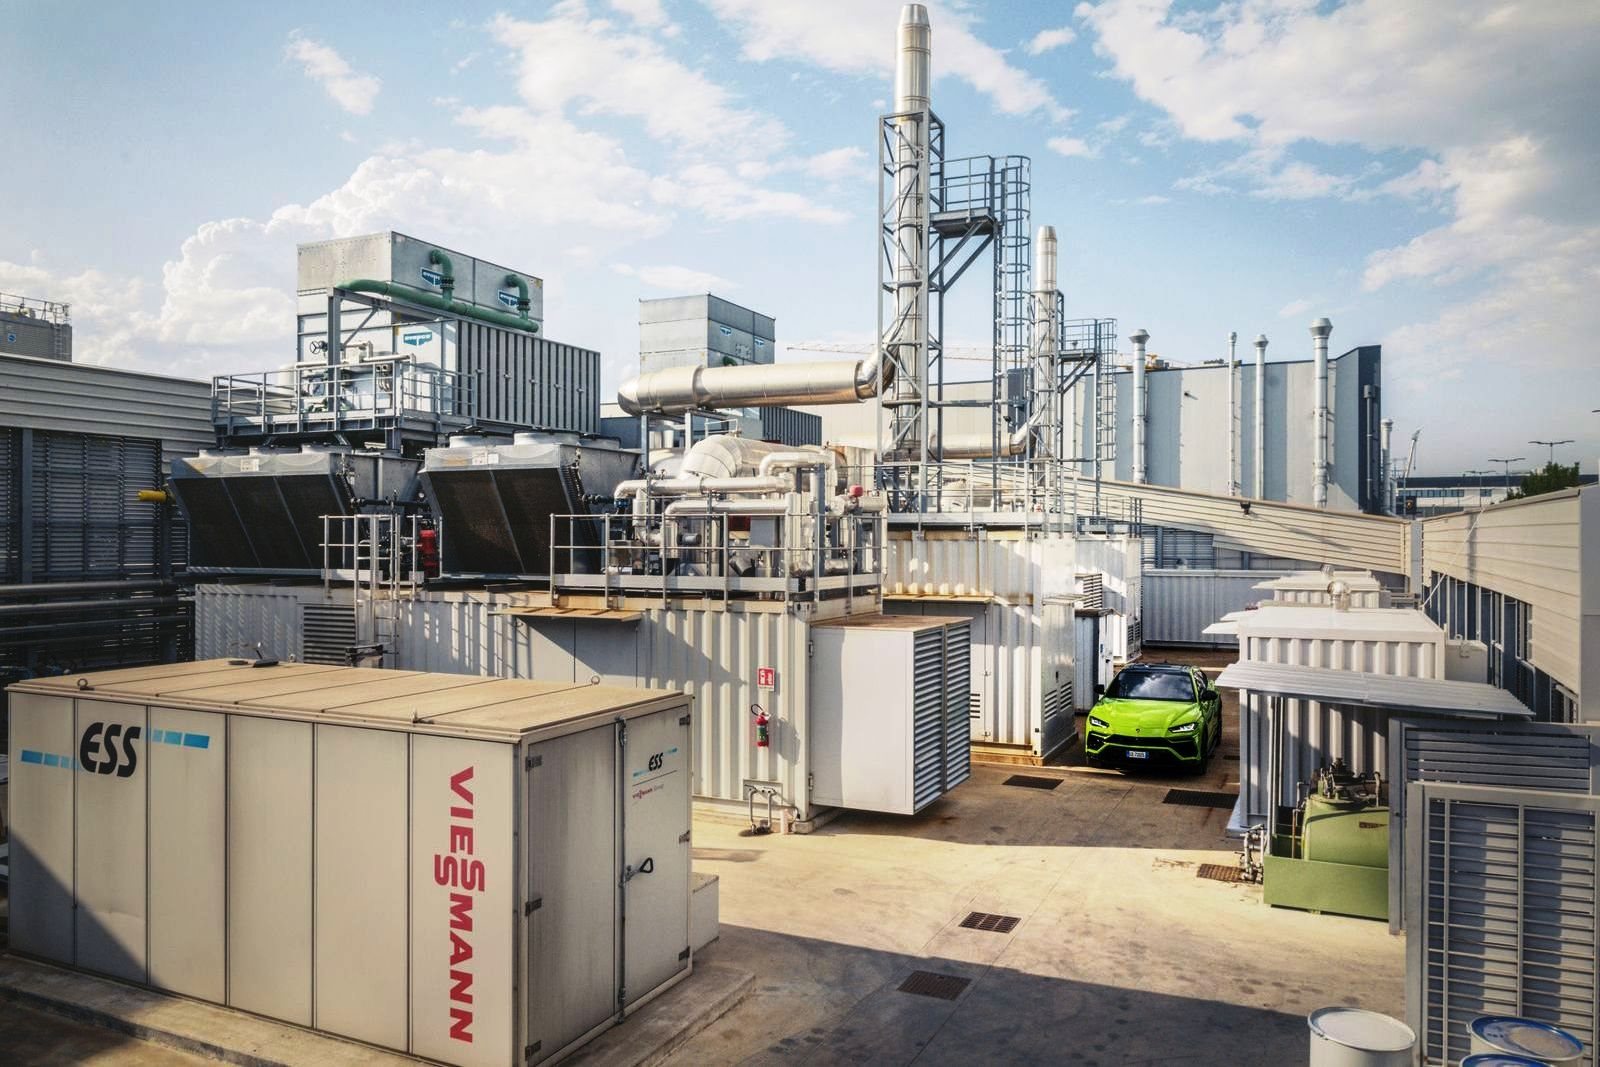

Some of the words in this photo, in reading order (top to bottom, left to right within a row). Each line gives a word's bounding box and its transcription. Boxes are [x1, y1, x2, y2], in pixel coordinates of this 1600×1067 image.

[79, 721, 141, 778] ESS
[648, 752, 664, 772] ESS
[434, 765, 485, 1044] VIESSMANN
